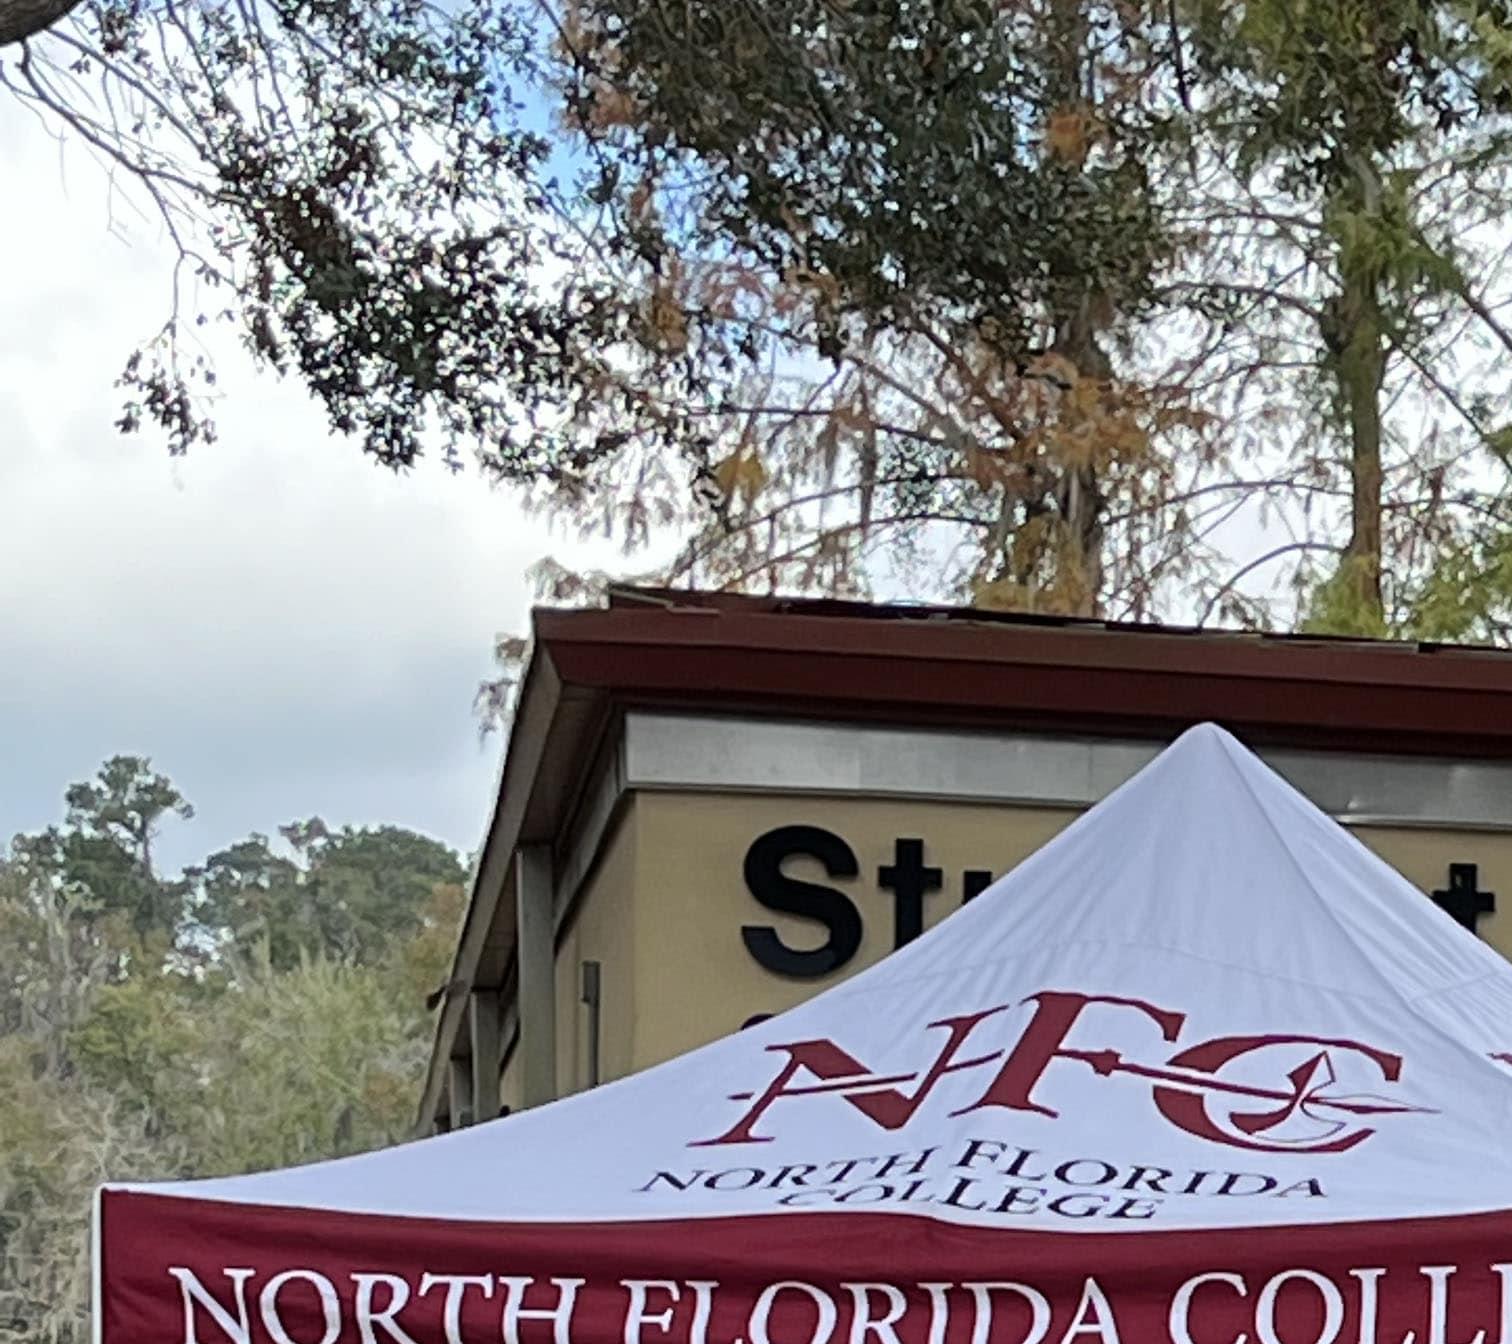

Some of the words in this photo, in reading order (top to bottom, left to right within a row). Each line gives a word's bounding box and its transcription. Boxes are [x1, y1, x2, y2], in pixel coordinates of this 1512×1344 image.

[686, 990, 1403, 1154] NFC
[634, 1144, 942, 1193] NORTH
[949, 1138, 1328, 1198] FLORIDA
[777, 1176, 1166, 1220] COLLEGE
